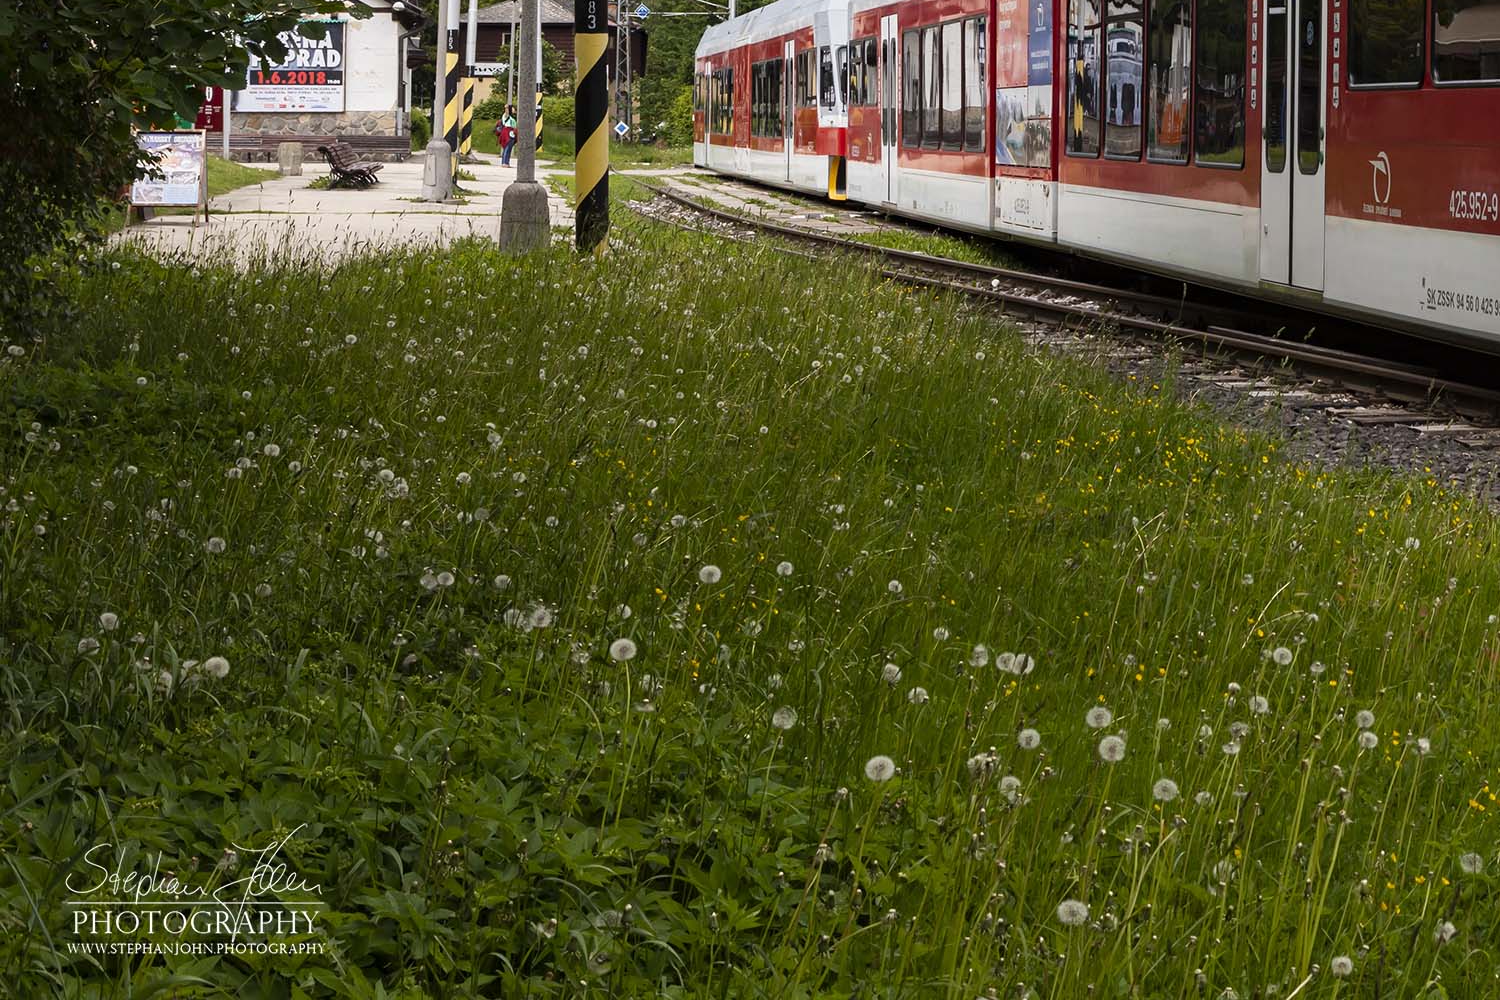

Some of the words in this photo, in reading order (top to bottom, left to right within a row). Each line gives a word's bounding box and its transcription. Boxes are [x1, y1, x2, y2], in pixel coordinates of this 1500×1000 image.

[257, 71, 326, 85] 1.6.2018
[1449, 190, 1498, 222] 425.952-9
[1427, 288, 1436, 305] SK
[1437, 290, 1455, 309] ZSSK
[1456, 294, 1464, 310] 94
[1465, 295, 1474, 312] 56
[1481, 297, 1493, 315] 425
